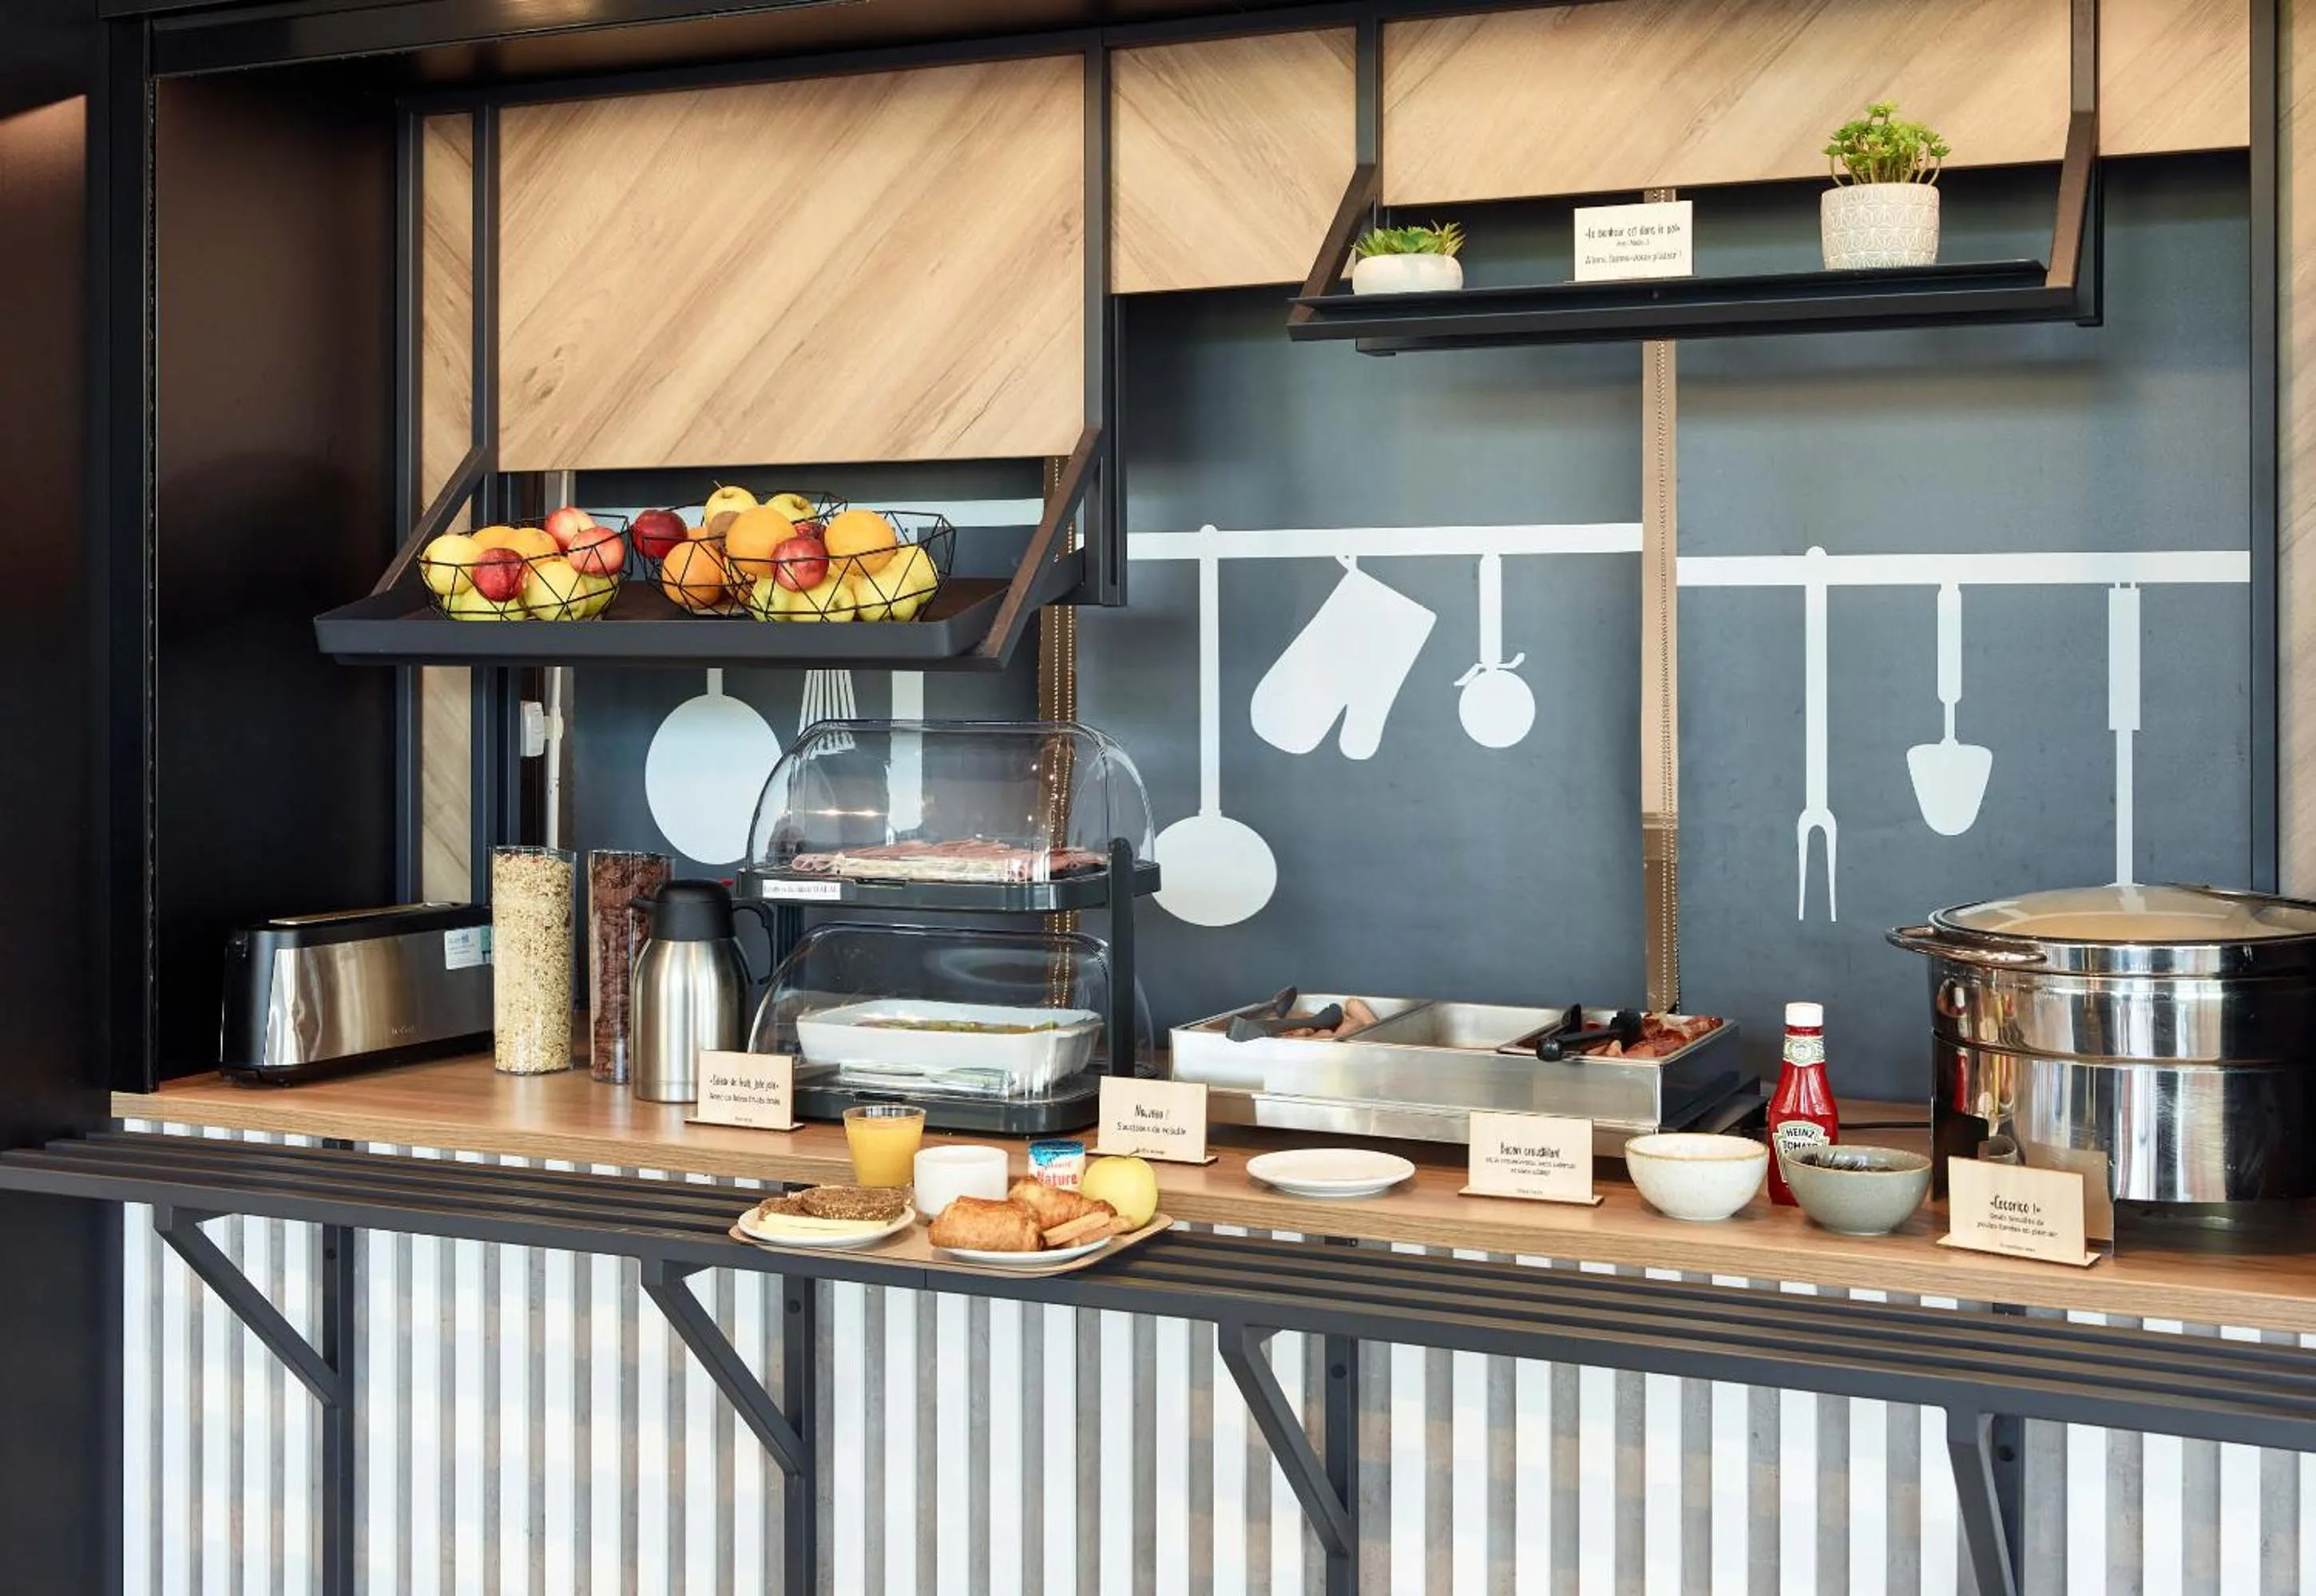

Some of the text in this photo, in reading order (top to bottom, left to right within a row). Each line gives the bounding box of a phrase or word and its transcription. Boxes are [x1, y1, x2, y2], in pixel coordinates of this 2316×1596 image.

[1786, 1127, 1815, 1139] HEINZ
[1500, 1142, 1521, 1155] Bacon
[1037, 1170, 1078, 1186] Nature
